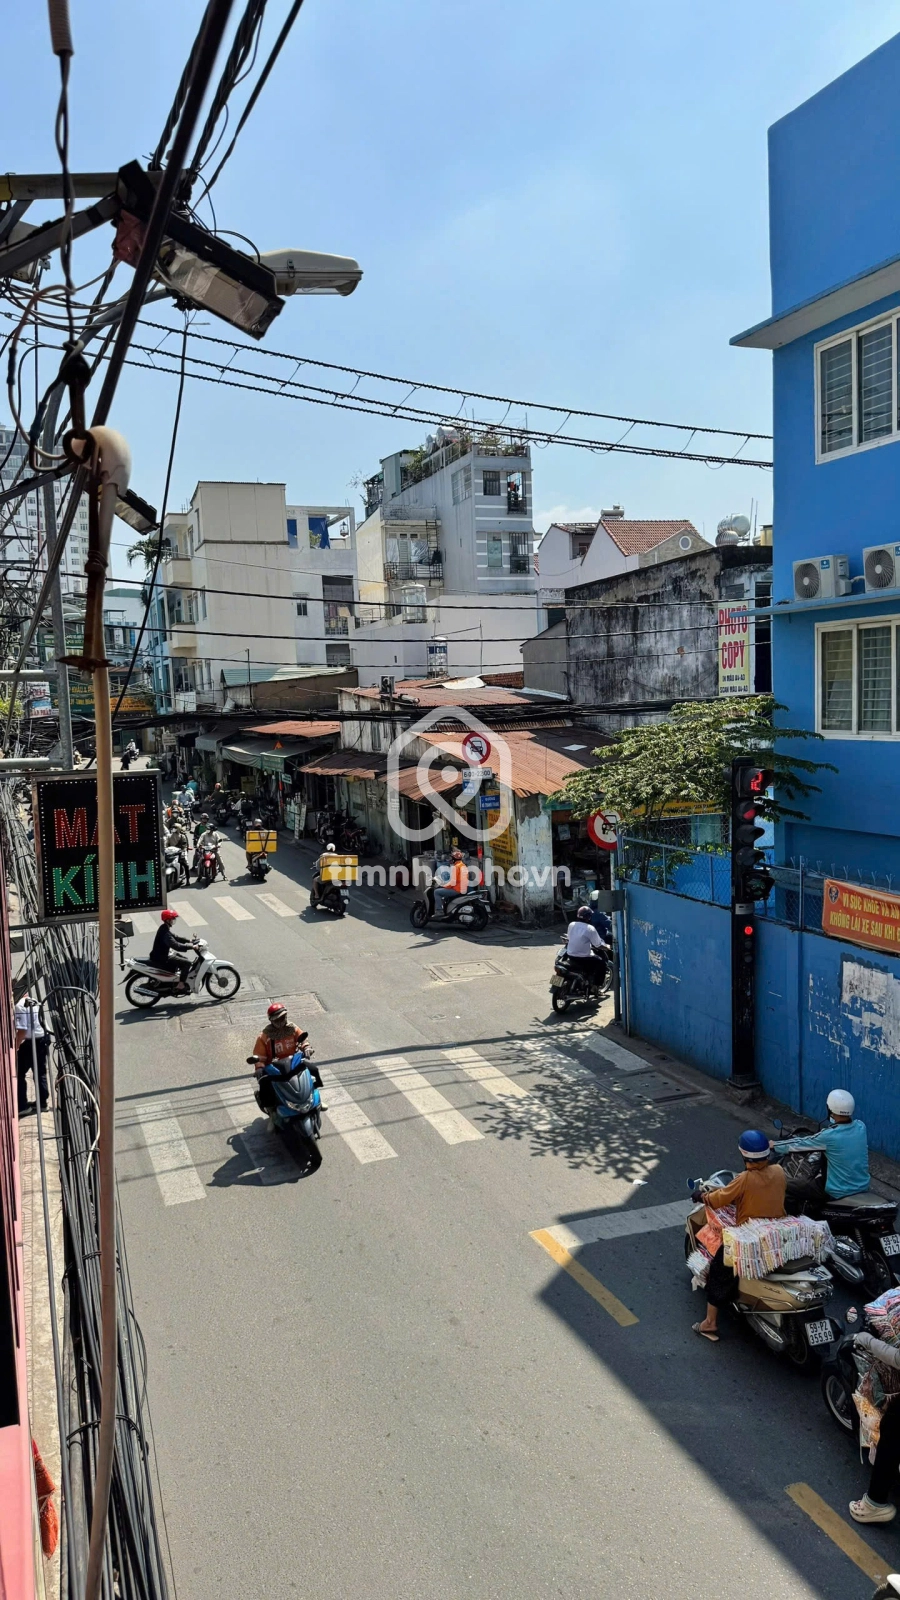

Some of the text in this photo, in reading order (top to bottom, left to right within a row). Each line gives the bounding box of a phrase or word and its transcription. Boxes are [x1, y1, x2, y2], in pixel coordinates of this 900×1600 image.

[719, 605, 748, 636] PHOTO
[722, 640, 745, 669] COPY
[850, 893, 862, 910] SỨC
[830, 910, 850, 930] KHÔNG
[850, 913, 860, 932] LÁI
[861, 917, 869, 934] XE
[870, 920, 883, 938] SAU
[884, 923, 895, 941] KHI
[809, 1320, 828, 1334] 59-P2
[809, 1330, 833, 1345] 355.99
